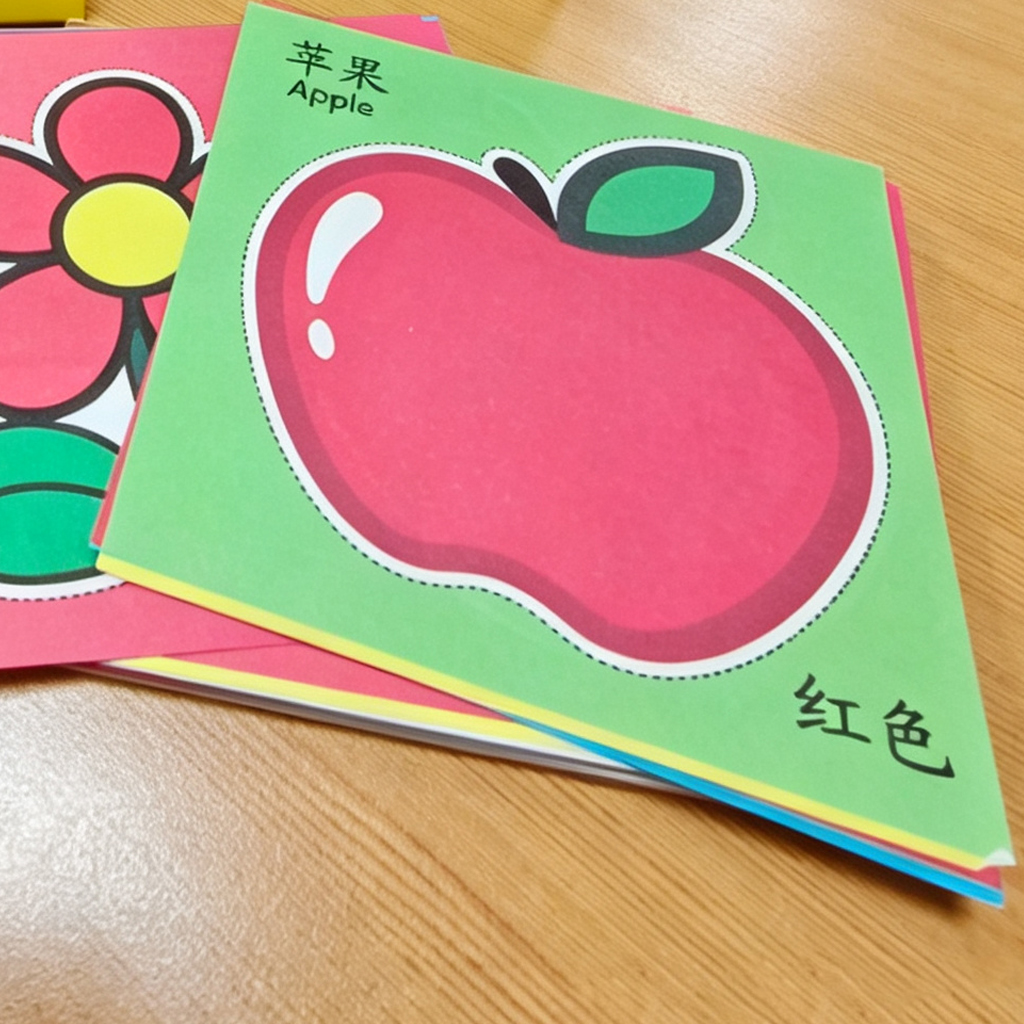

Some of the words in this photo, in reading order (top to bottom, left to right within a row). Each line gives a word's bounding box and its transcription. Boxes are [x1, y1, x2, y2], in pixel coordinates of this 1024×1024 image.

[285, 40, 390, 95] 苹果
[287, 79, 374, 116] Apple
[794, 673, 955, 778] 红色
